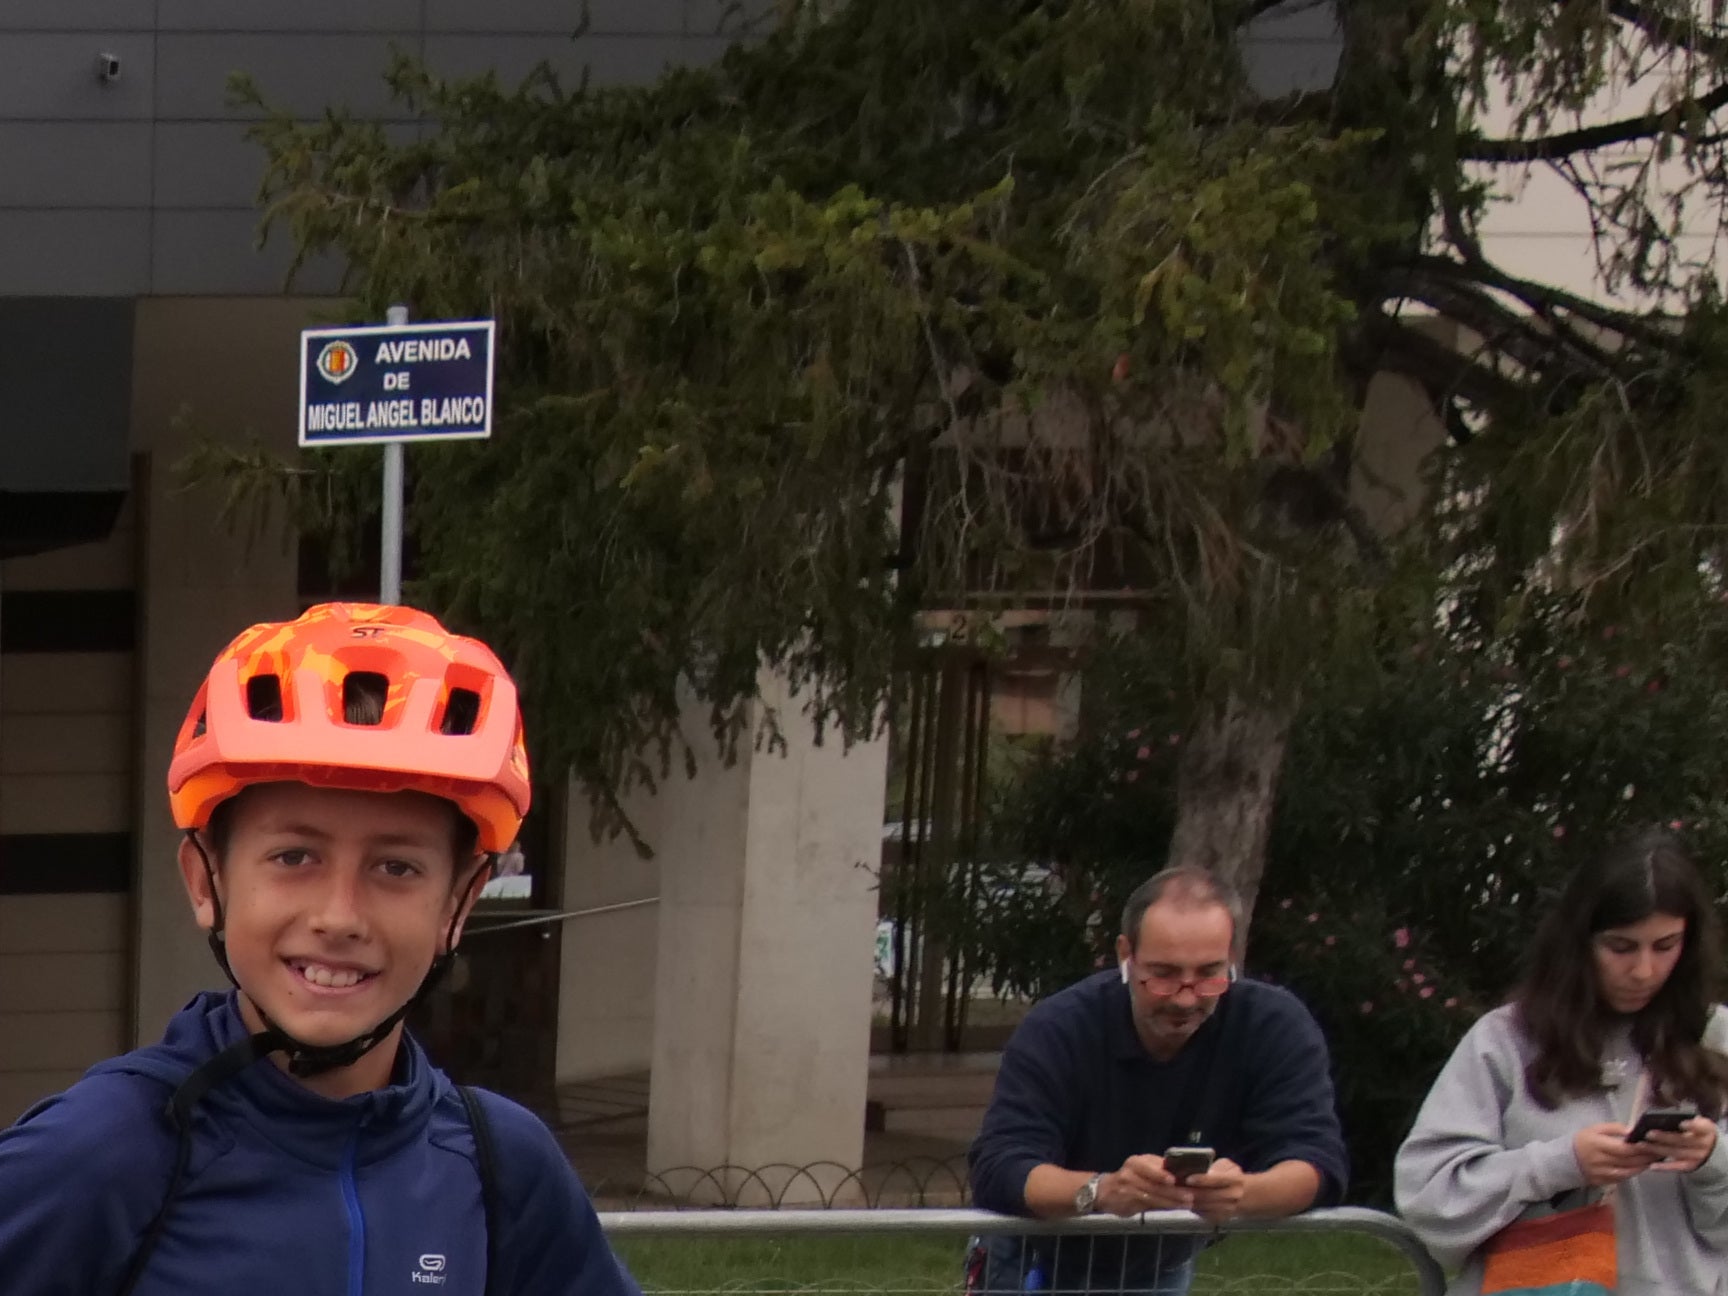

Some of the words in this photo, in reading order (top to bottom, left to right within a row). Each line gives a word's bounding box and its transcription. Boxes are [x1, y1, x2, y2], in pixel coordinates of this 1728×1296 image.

[375, 338, 472, 364] AVENIDA
[383, 372, 411, 391] DE
[308, 401, 364, 431] MIGUEL
[367, 399, 418, 427] ANGEL
[420, 396, 485, 424] BLANCO
